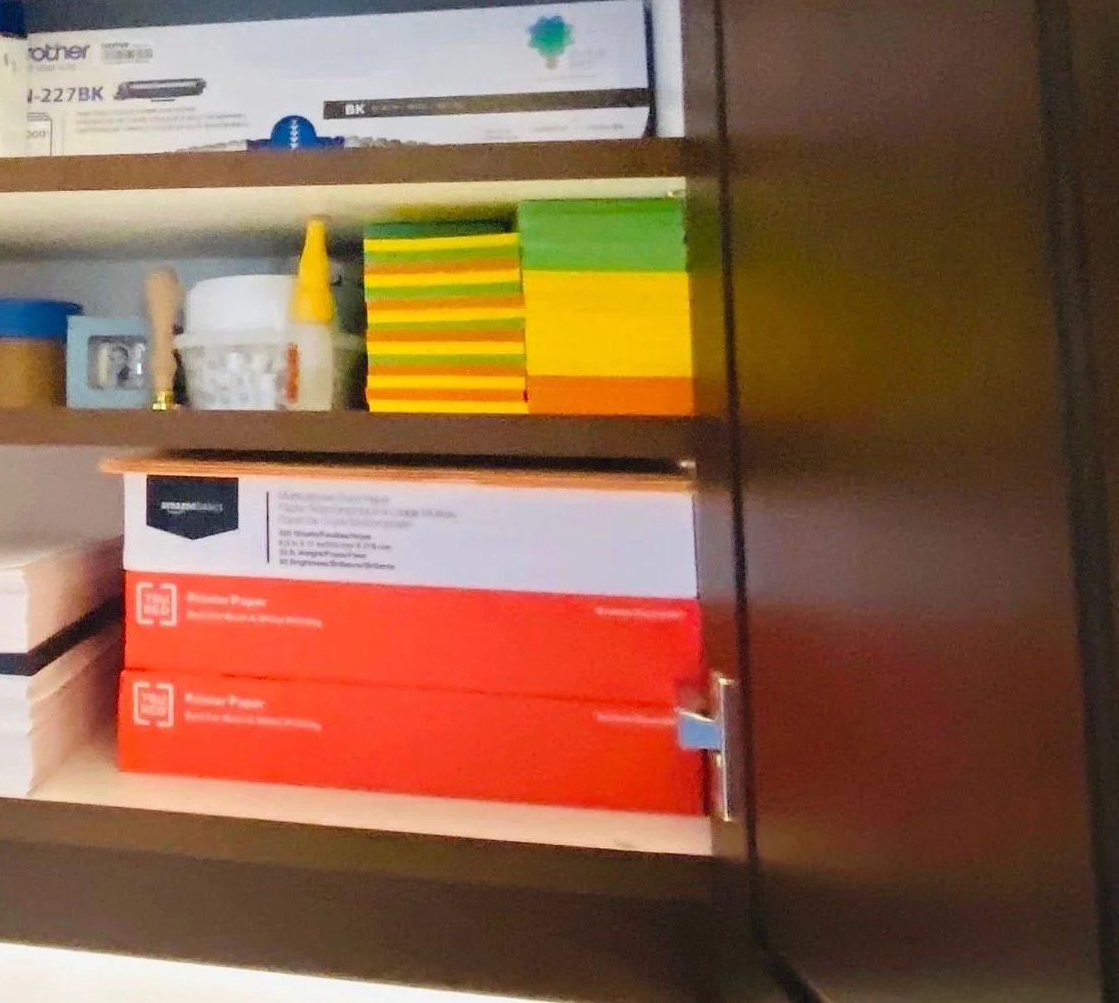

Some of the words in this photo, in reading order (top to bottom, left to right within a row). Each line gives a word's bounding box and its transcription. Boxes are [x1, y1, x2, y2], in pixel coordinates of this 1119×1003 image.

[28, 42, 90, 62] rother
[27, 86, 105, 103] -227BK
[345, 103, 366, 115] BK
